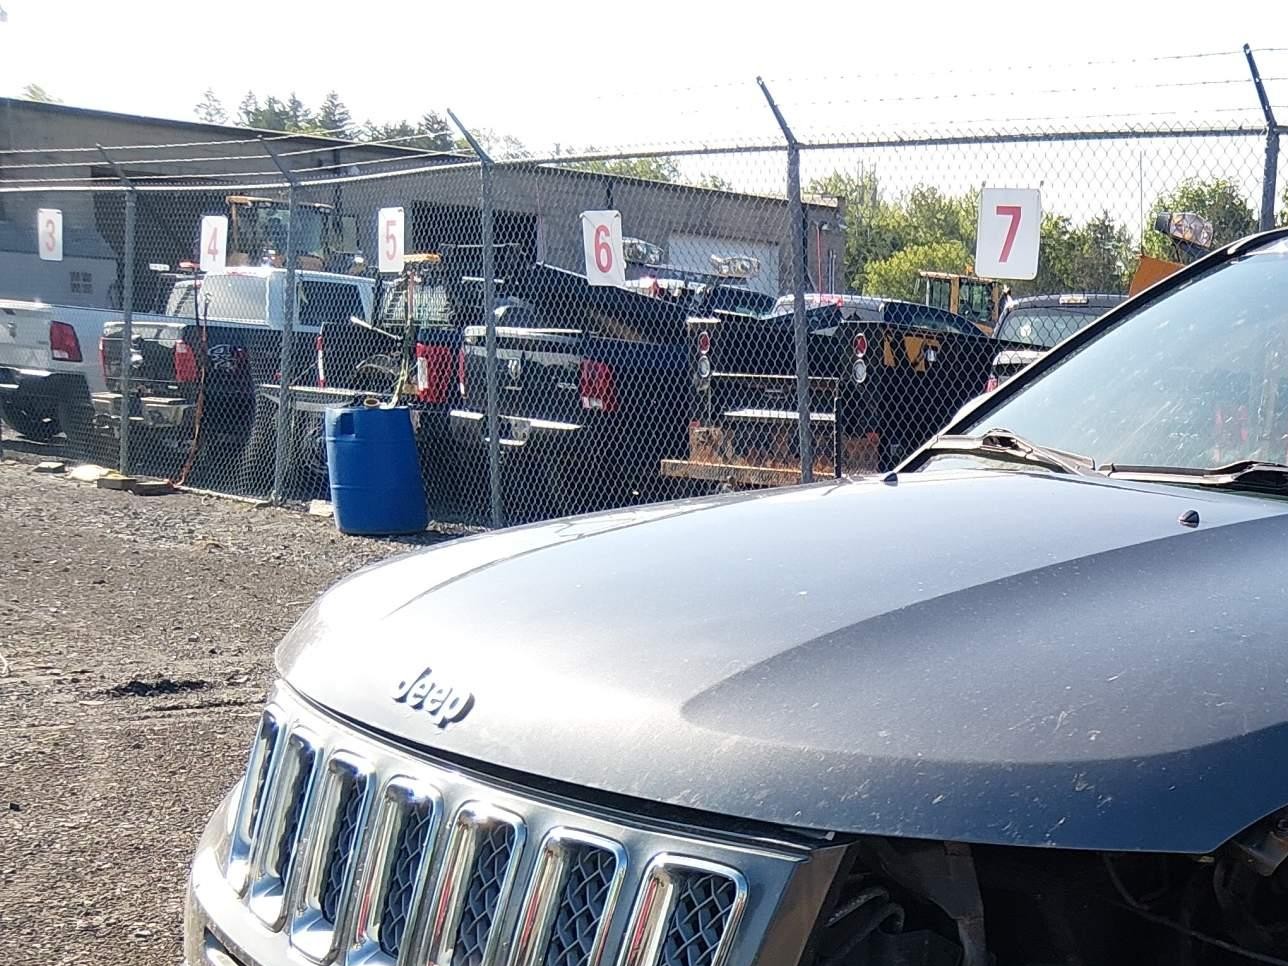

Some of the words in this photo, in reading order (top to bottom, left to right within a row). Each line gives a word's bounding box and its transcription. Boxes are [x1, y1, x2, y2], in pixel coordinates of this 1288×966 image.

[45, 218, 57, 252] 3
[207, 226, 219, 262] 4
[386, 219, 397, 261] 5
[593, 224, 613, 273] 6
[995, 204, 1022, 263] 7
[391, 665, 476, 730] Jeep
